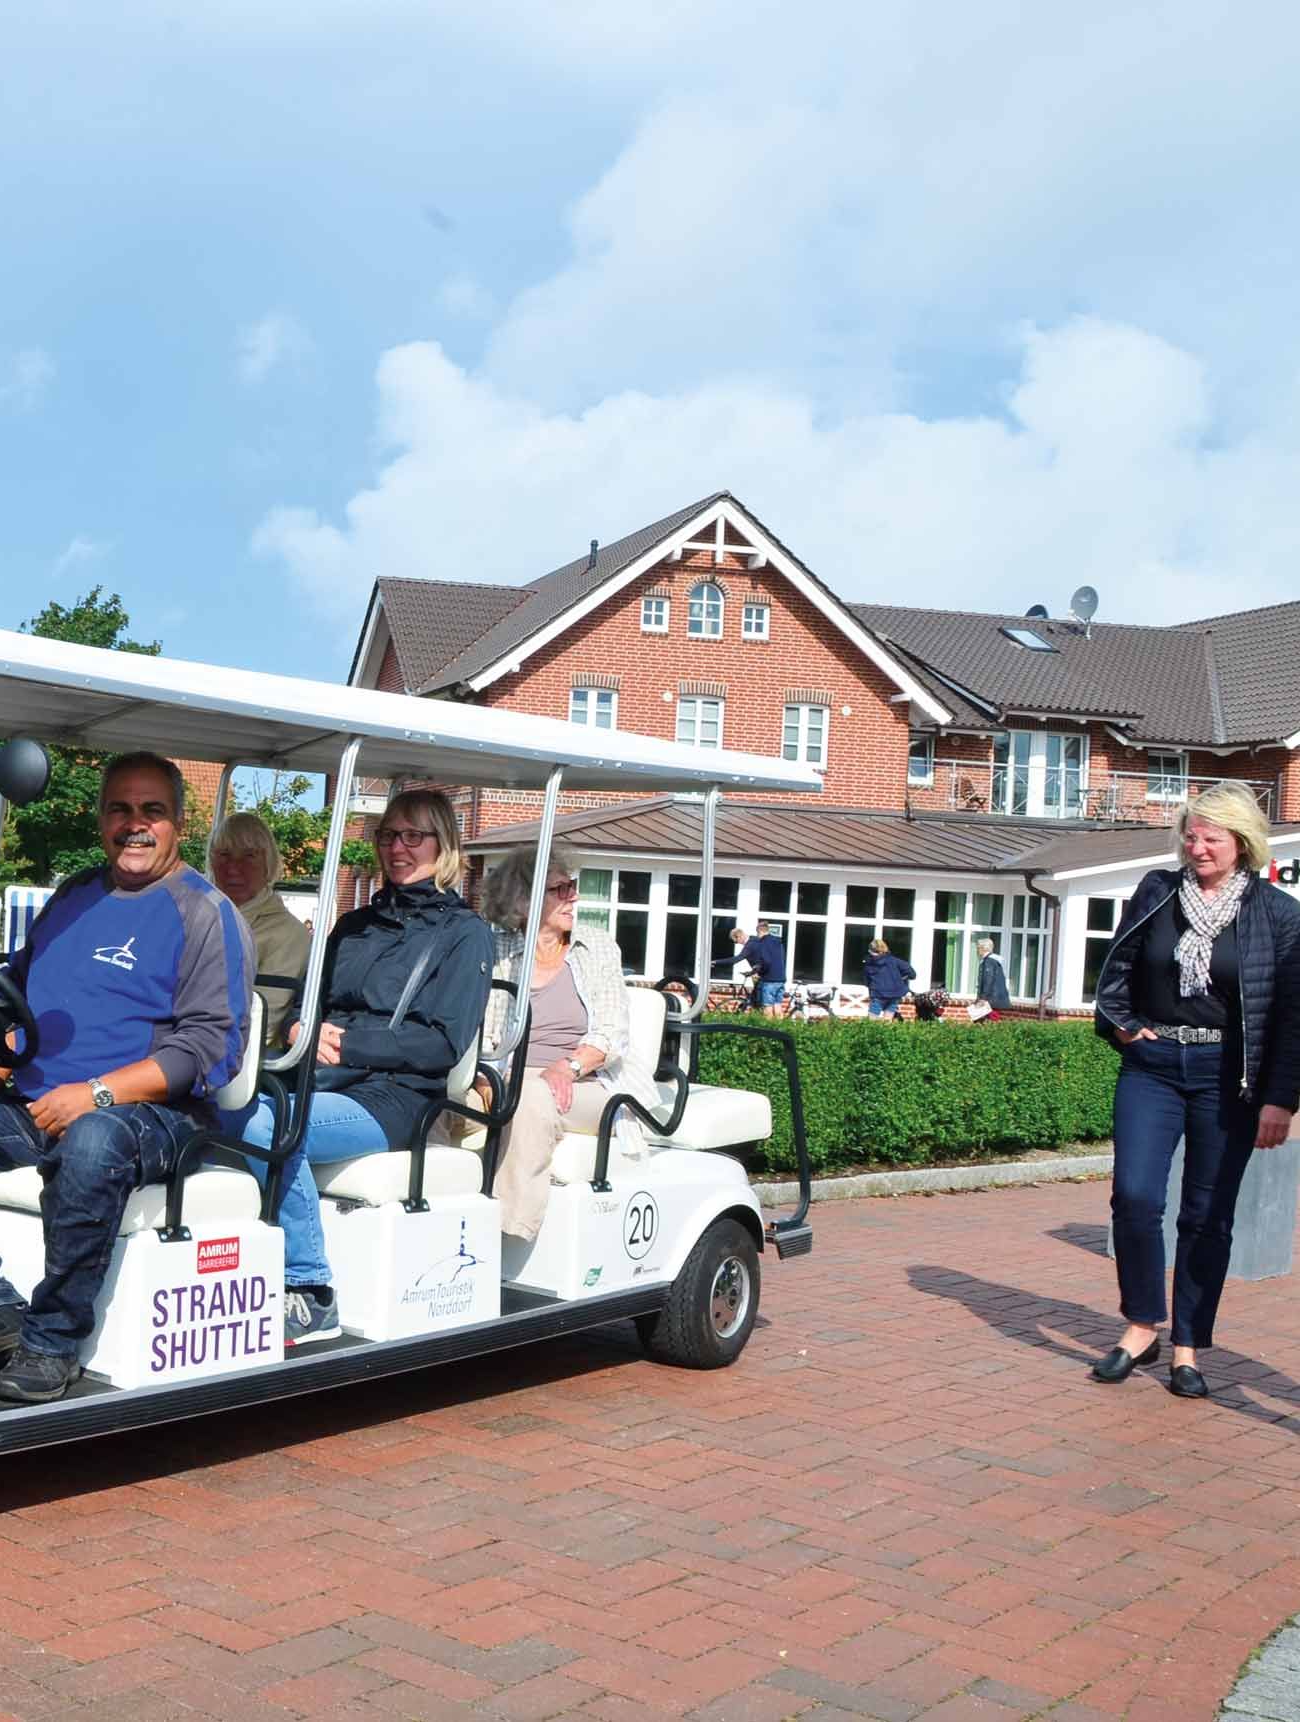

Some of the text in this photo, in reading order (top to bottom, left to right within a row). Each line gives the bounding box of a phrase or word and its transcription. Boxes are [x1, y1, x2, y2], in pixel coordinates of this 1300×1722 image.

[628, 1204, 654, 1245] 20
[199, 1242, 238, 1259] AMRUM
[152, 1276, 276, 1329] STRAND-
[151, 1316, 272, 1372] SHUTTLE
